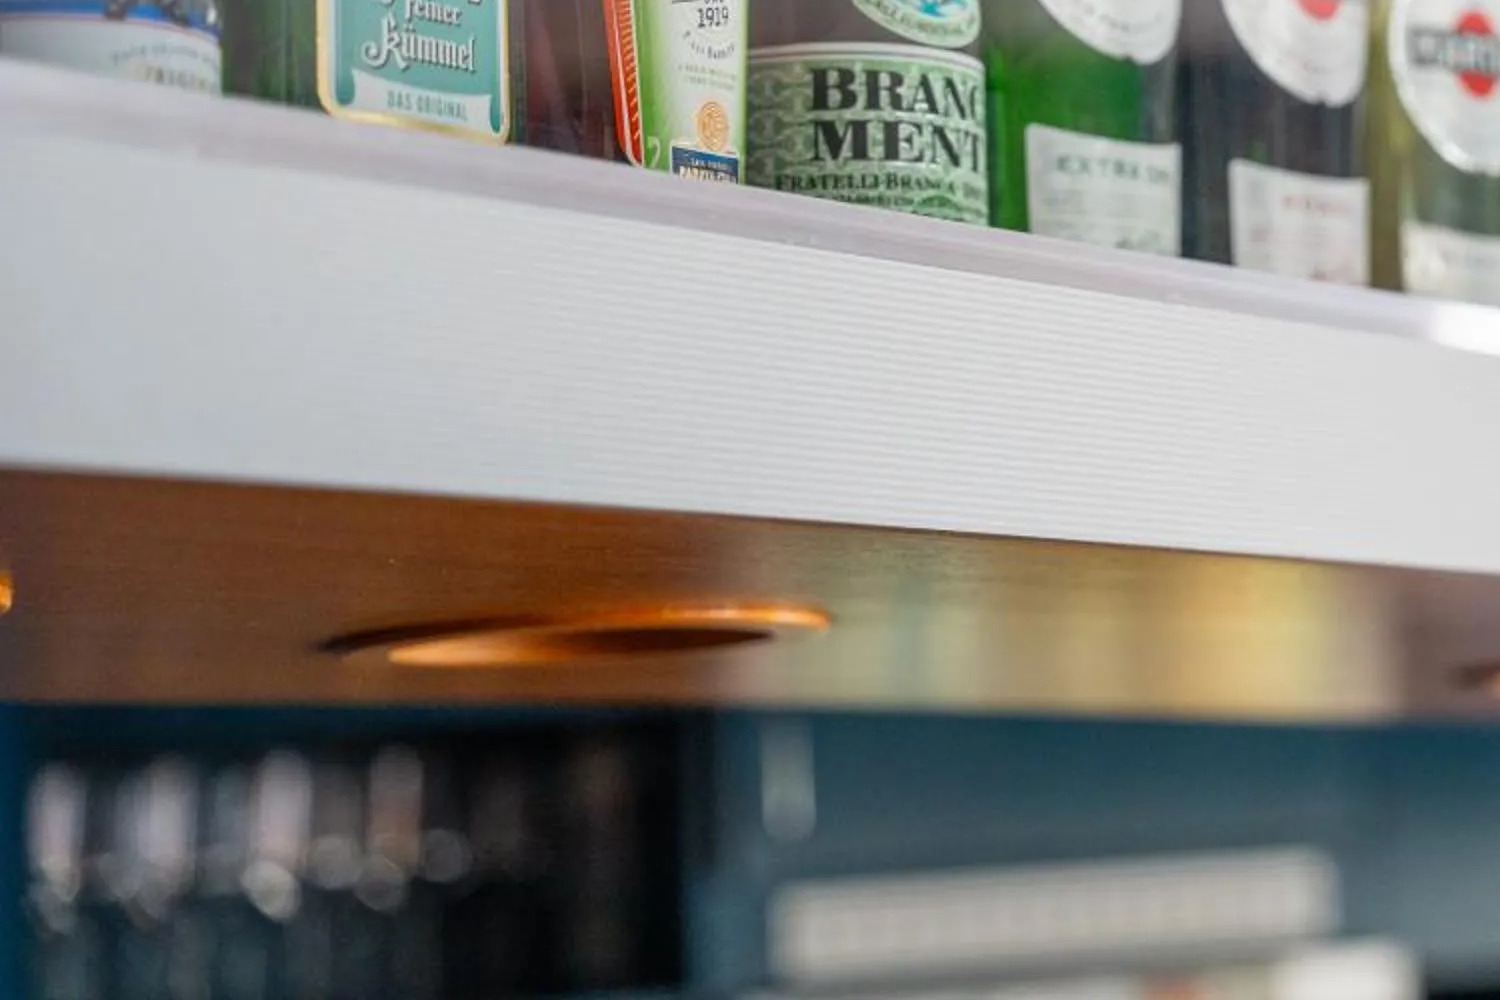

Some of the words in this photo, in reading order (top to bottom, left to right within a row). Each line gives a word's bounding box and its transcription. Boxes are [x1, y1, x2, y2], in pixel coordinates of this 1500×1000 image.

[698, 7, 729, 29] 1919
[387, 90, 413, 110] DAS
[417, 94, 469, 121] ORIGINAL
